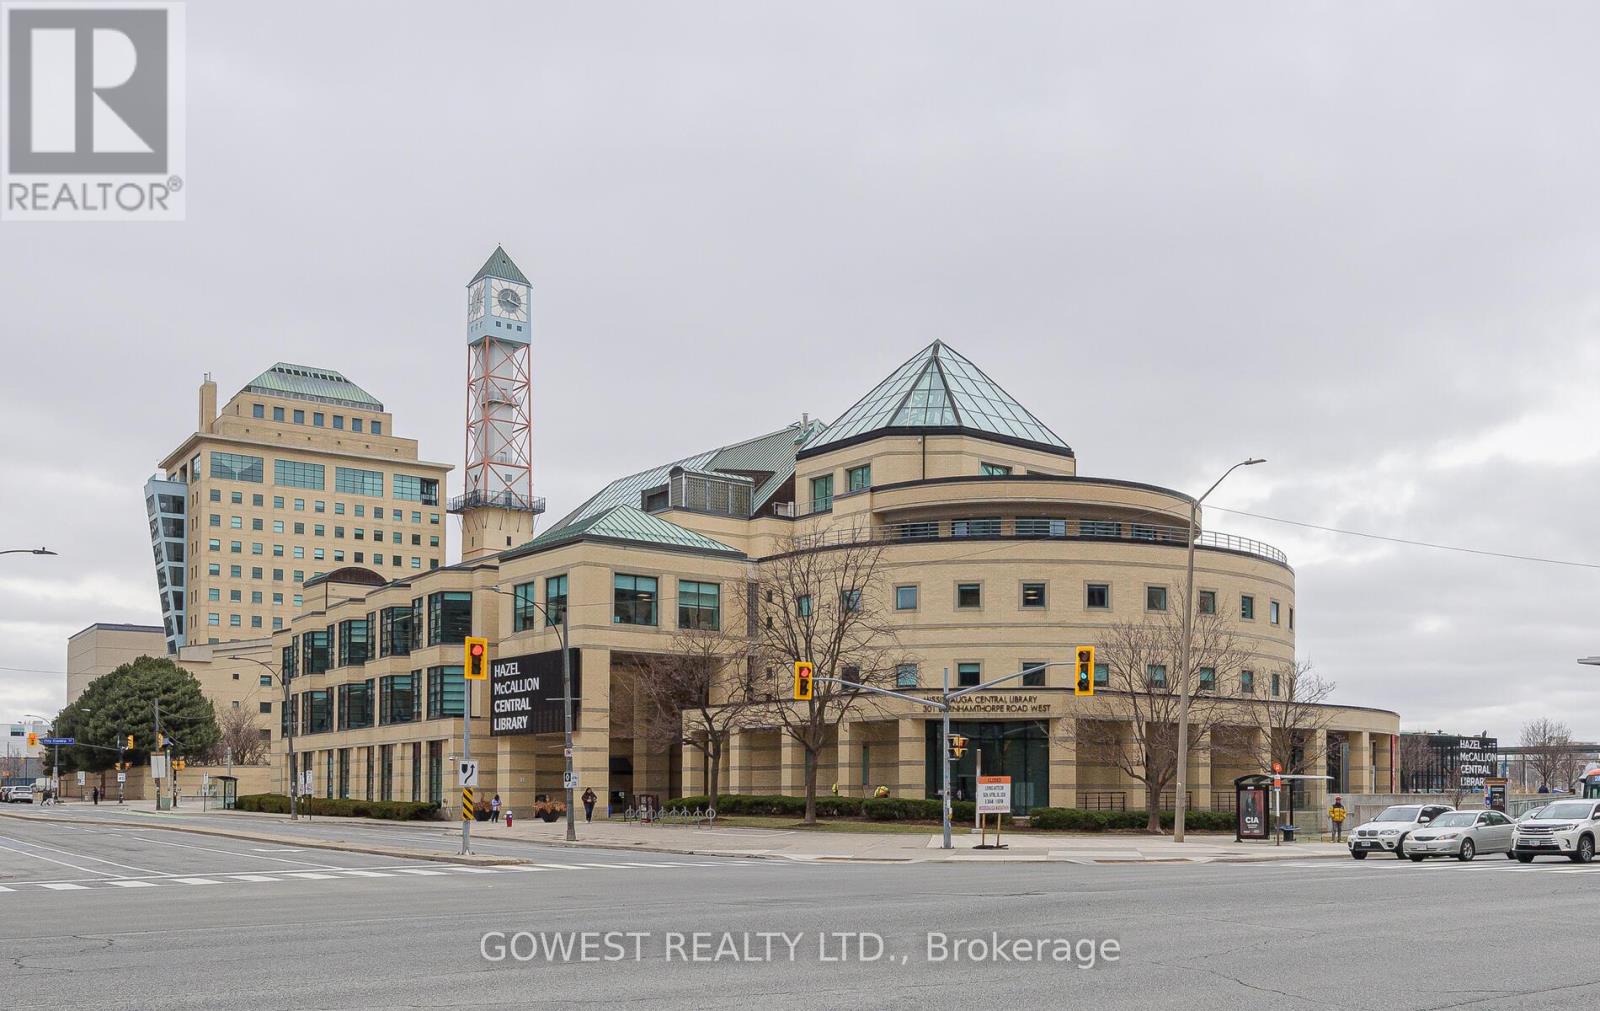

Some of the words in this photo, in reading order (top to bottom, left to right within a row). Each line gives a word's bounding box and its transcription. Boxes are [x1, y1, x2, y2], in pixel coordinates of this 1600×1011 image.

[494, 662, 520, 678] HAZEL
[494, 677, 540, 695] McCALLION
[494, 697, 532, 713] CENTRAL
[494, 716, 528, 731] LIBRARY
[1460, 740, 1481, 750] HAZEL
[1460, 752, 1497, 761] McCALLION
[1460, 765, 1491, 774] CENTRAL
[1460, 777, 1485, 786] LIBRAR
[1245, 816, 1260, 824] CIA
